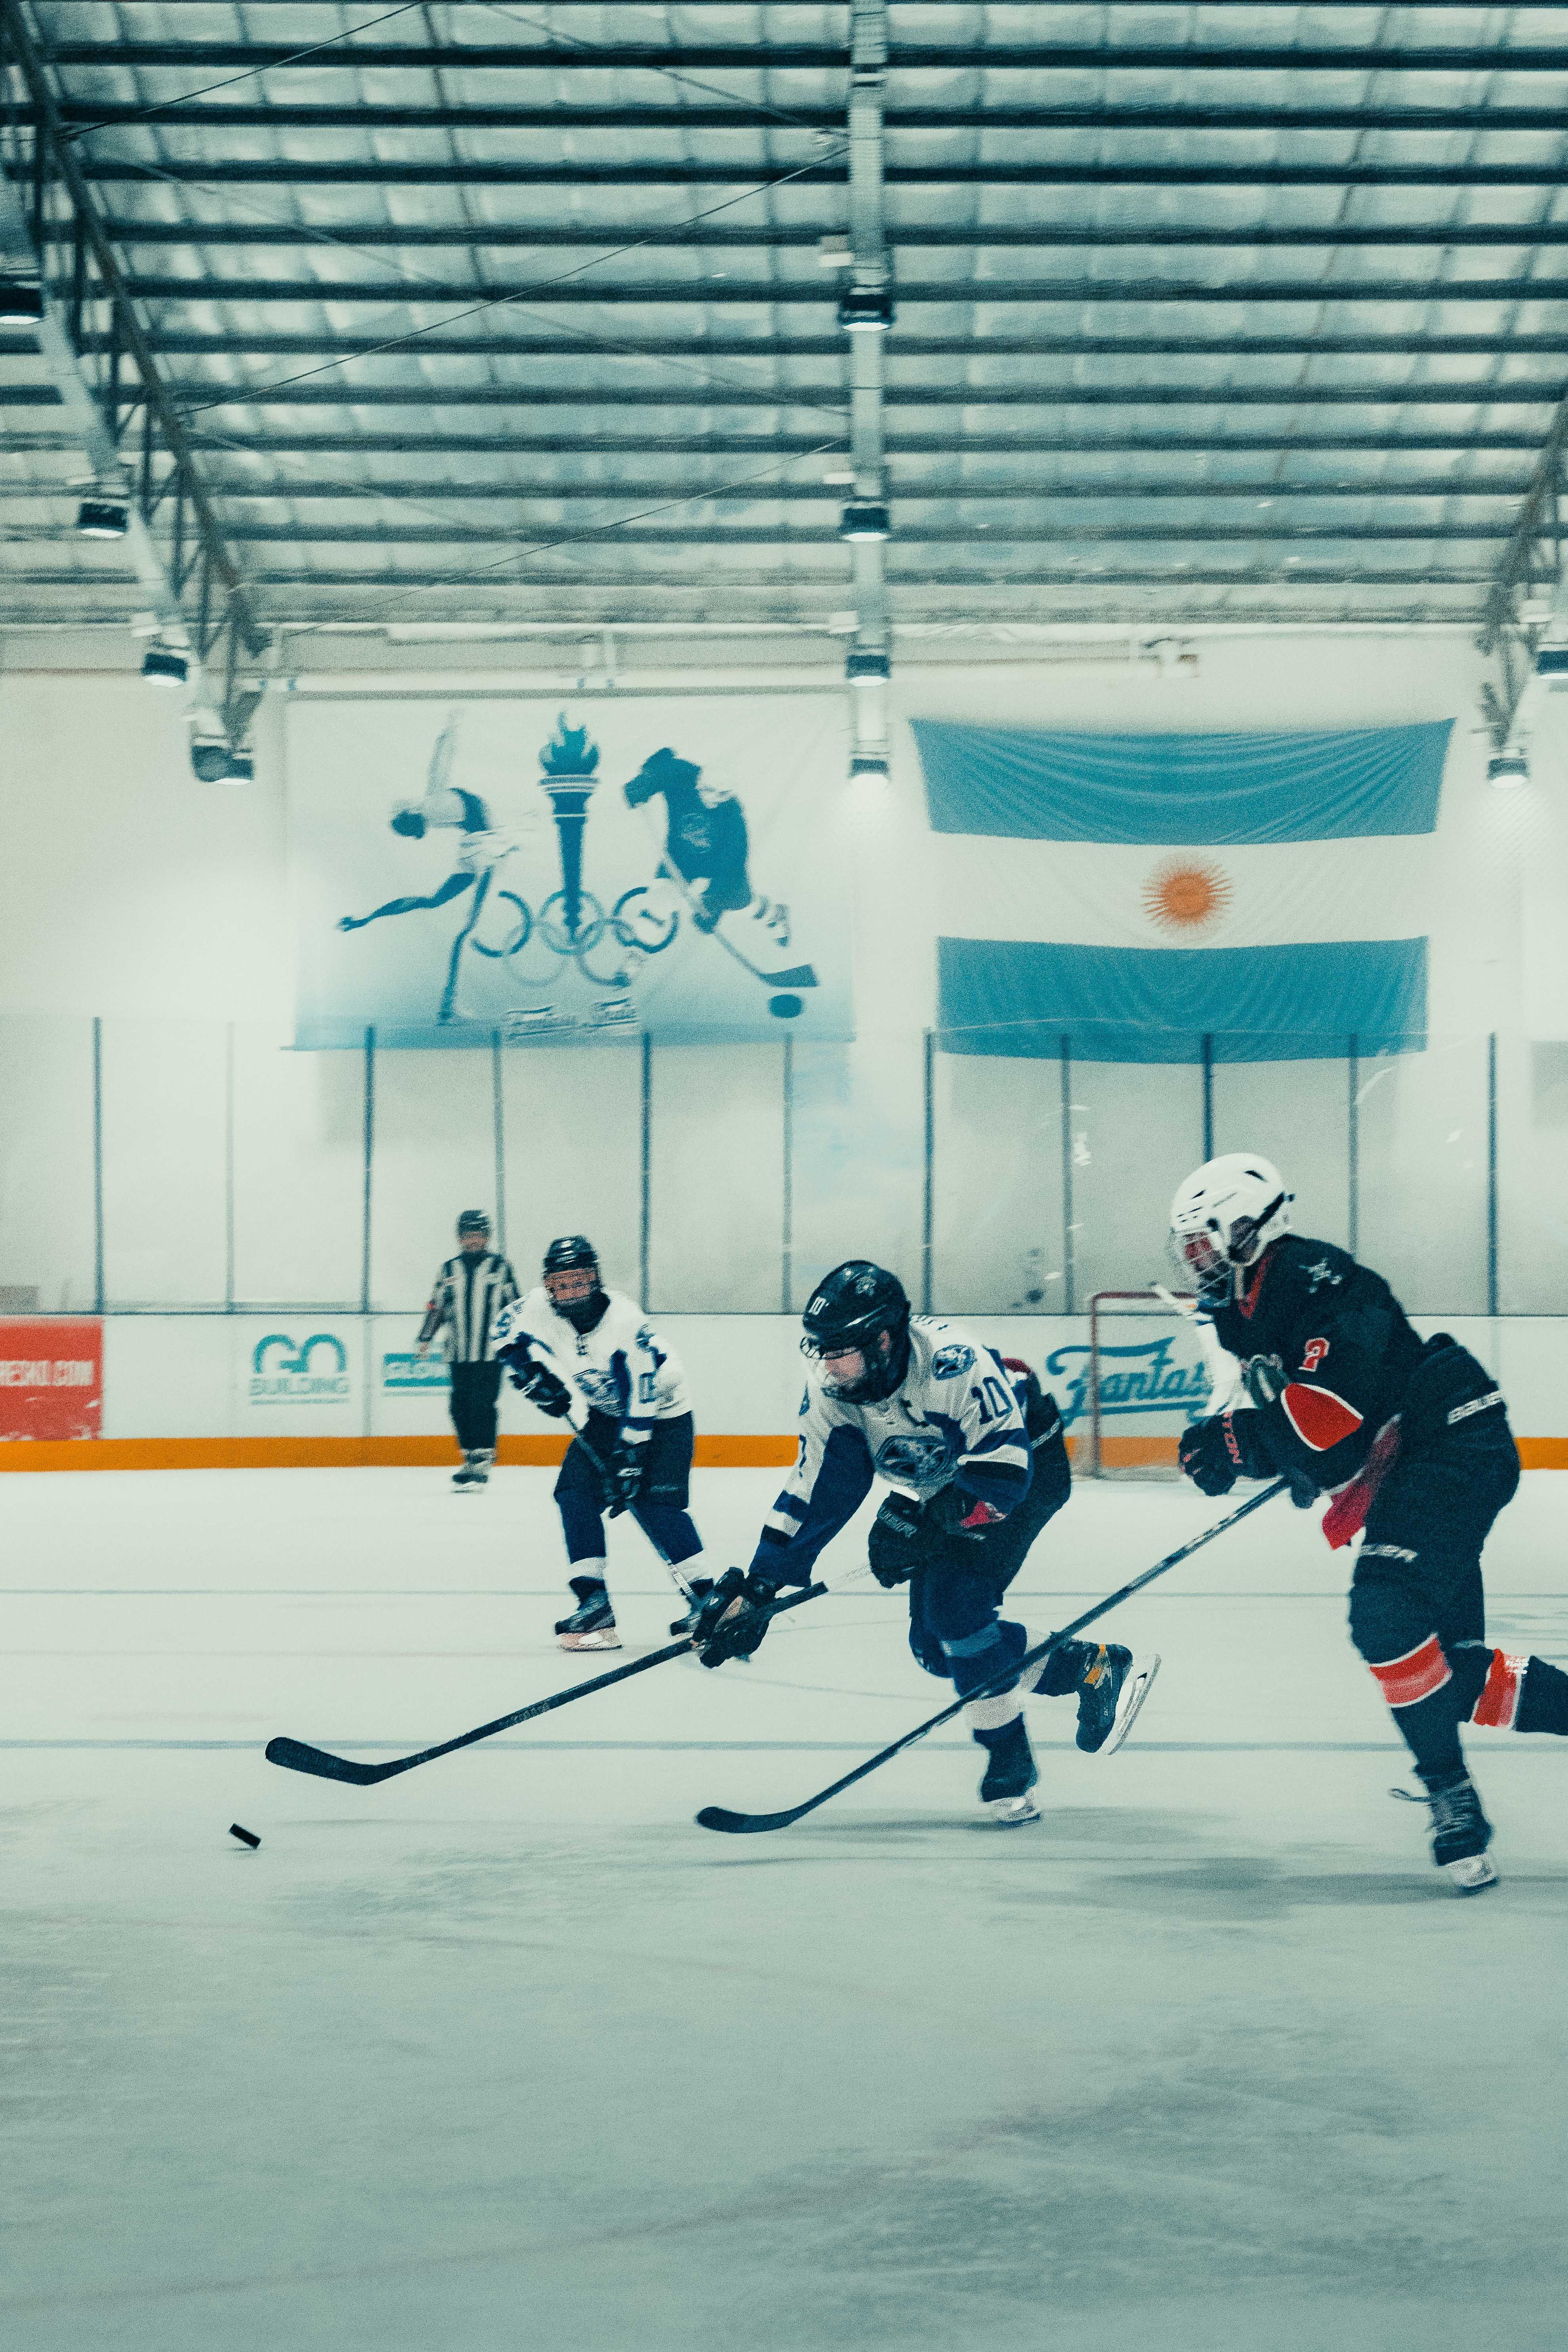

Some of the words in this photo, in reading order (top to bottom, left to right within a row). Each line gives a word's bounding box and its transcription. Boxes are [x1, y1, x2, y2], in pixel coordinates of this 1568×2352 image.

[253, 1333, 347, 1373] GO
[249, 1377, 350, 1396] BUILDING
[970, 1376, 1013, 1425] 10
